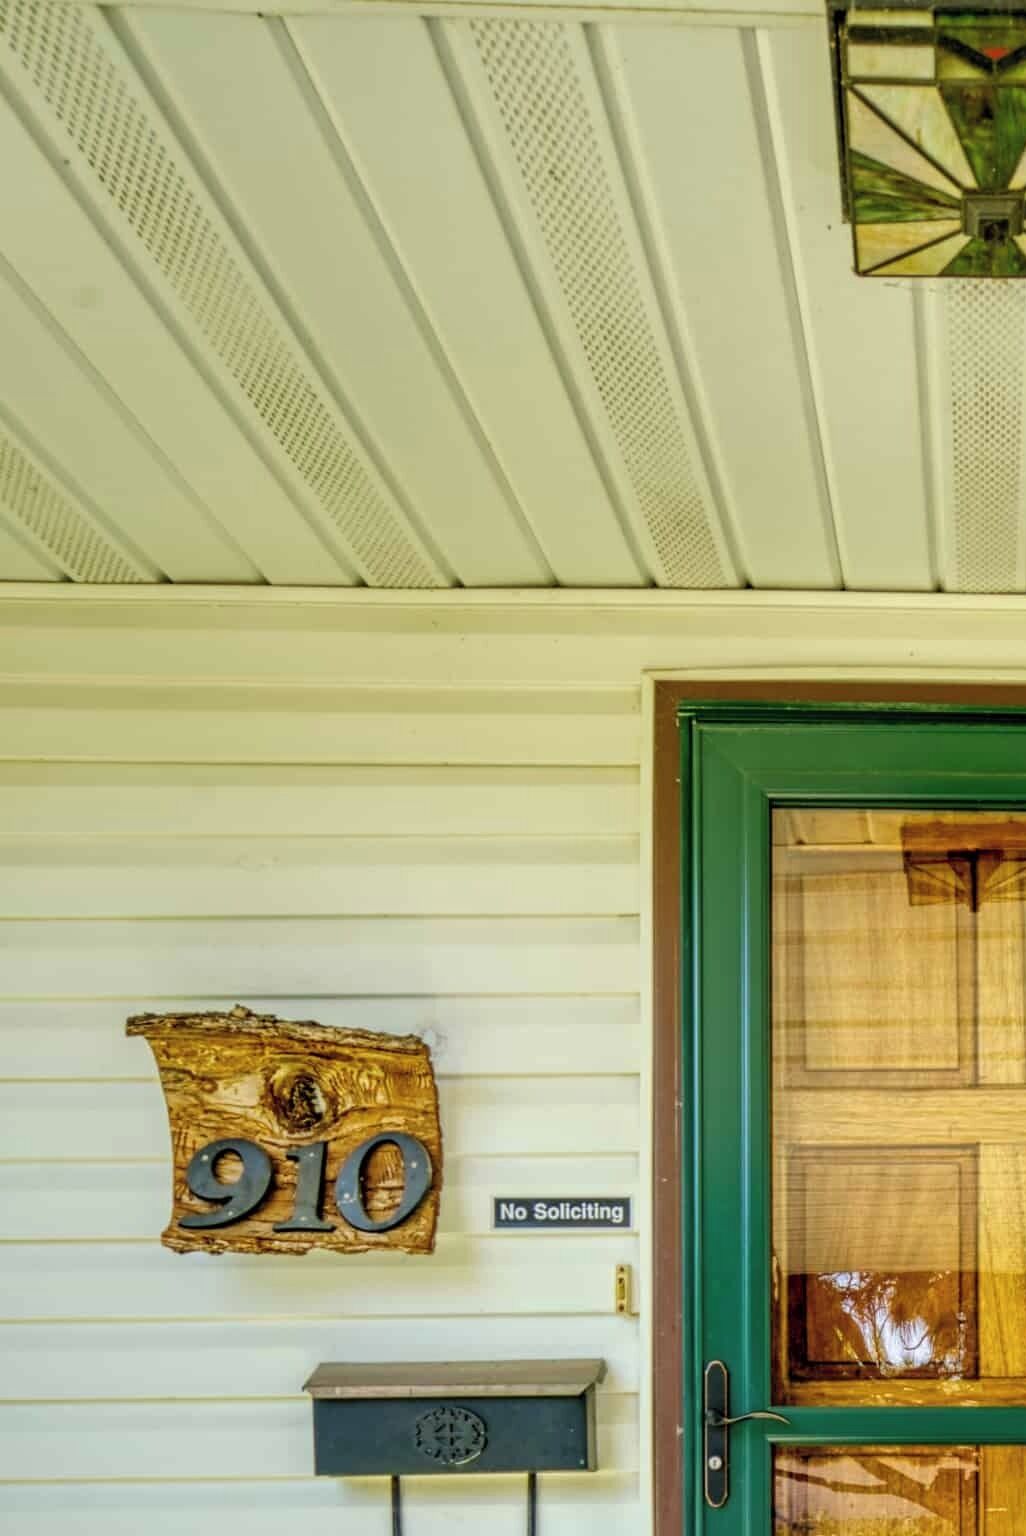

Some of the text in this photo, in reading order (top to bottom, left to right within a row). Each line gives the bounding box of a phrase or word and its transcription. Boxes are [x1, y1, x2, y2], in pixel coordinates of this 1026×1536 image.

[178, 1131, 433, 1233] 910
[500, 1202, 624, 1223] No Soliciting
